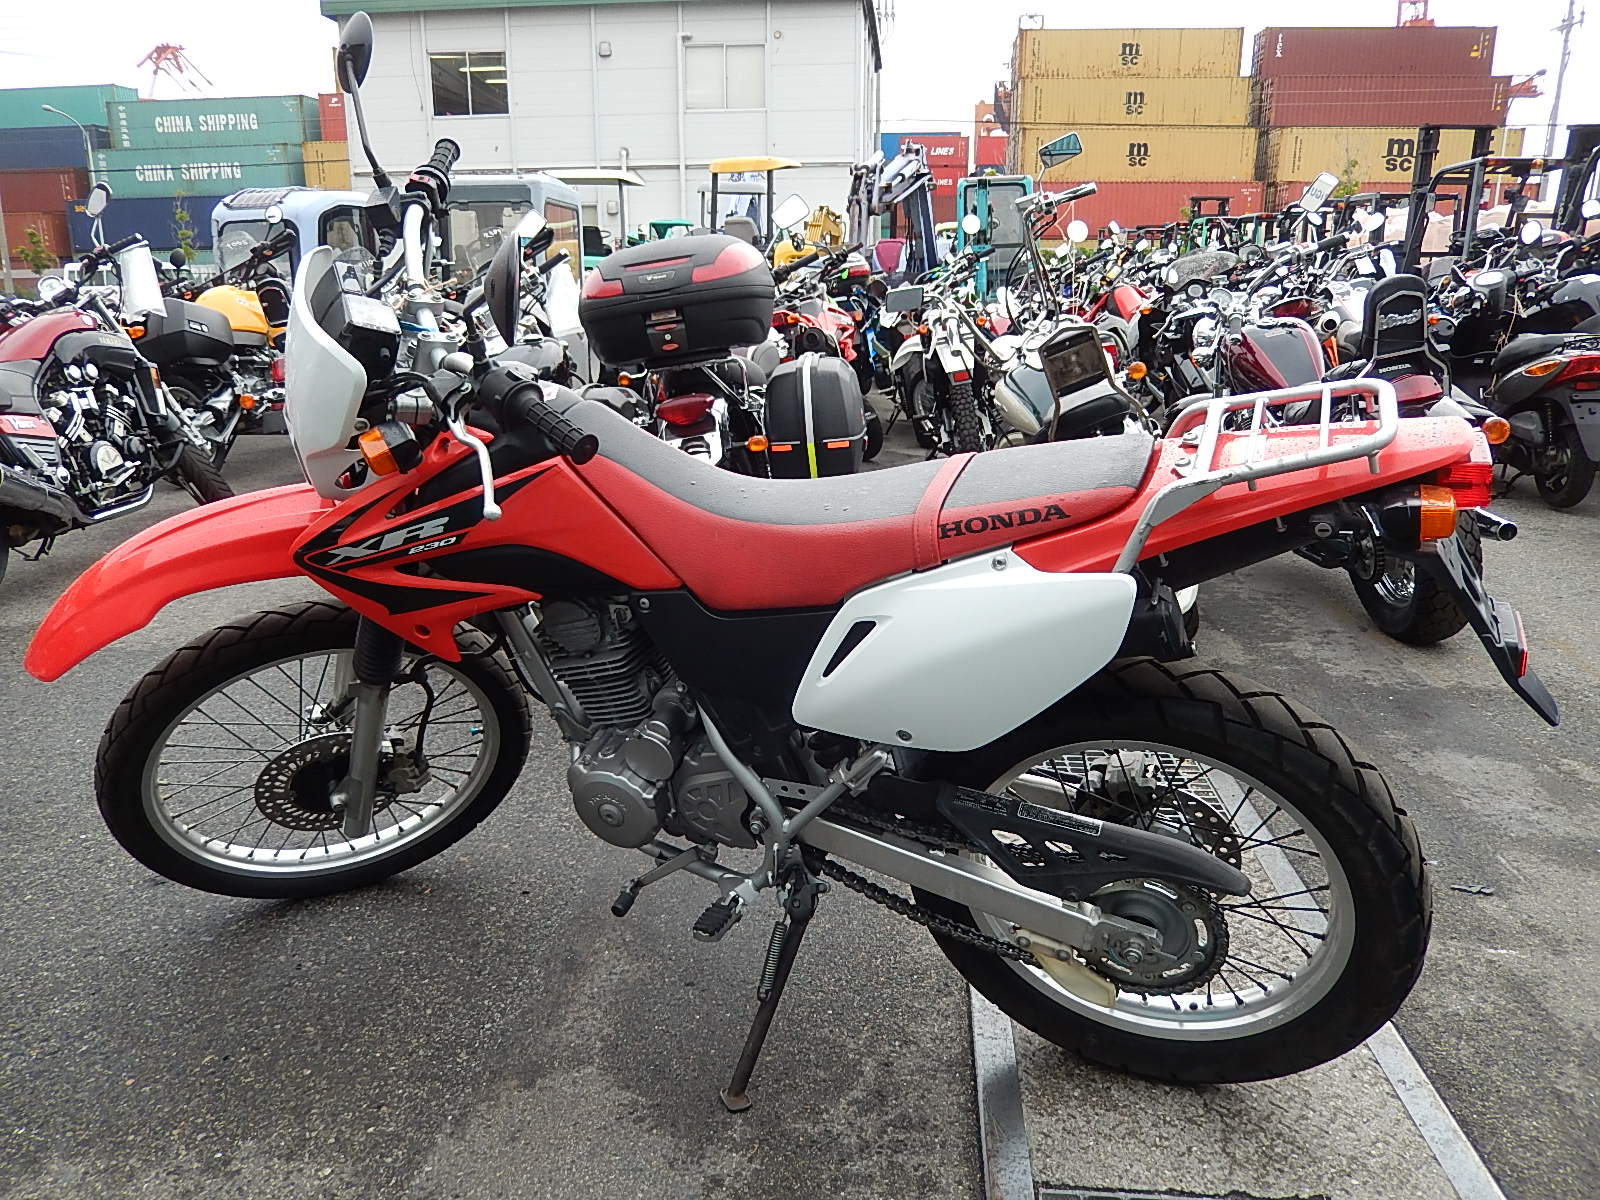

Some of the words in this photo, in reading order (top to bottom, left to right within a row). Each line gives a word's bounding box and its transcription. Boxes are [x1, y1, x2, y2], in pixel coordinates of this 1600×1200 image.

[154, 115, 194, 132] CHINA
[198, 112, 259, 131] SHIPPING
[135, 163, 175, 182] CHINA
[180, 161, 242, 180] SHIPPING
[938, 504, 1071, 539] HONDA
[326, 516, 450, 566] XR
[408, 536, 457, 555] 230
